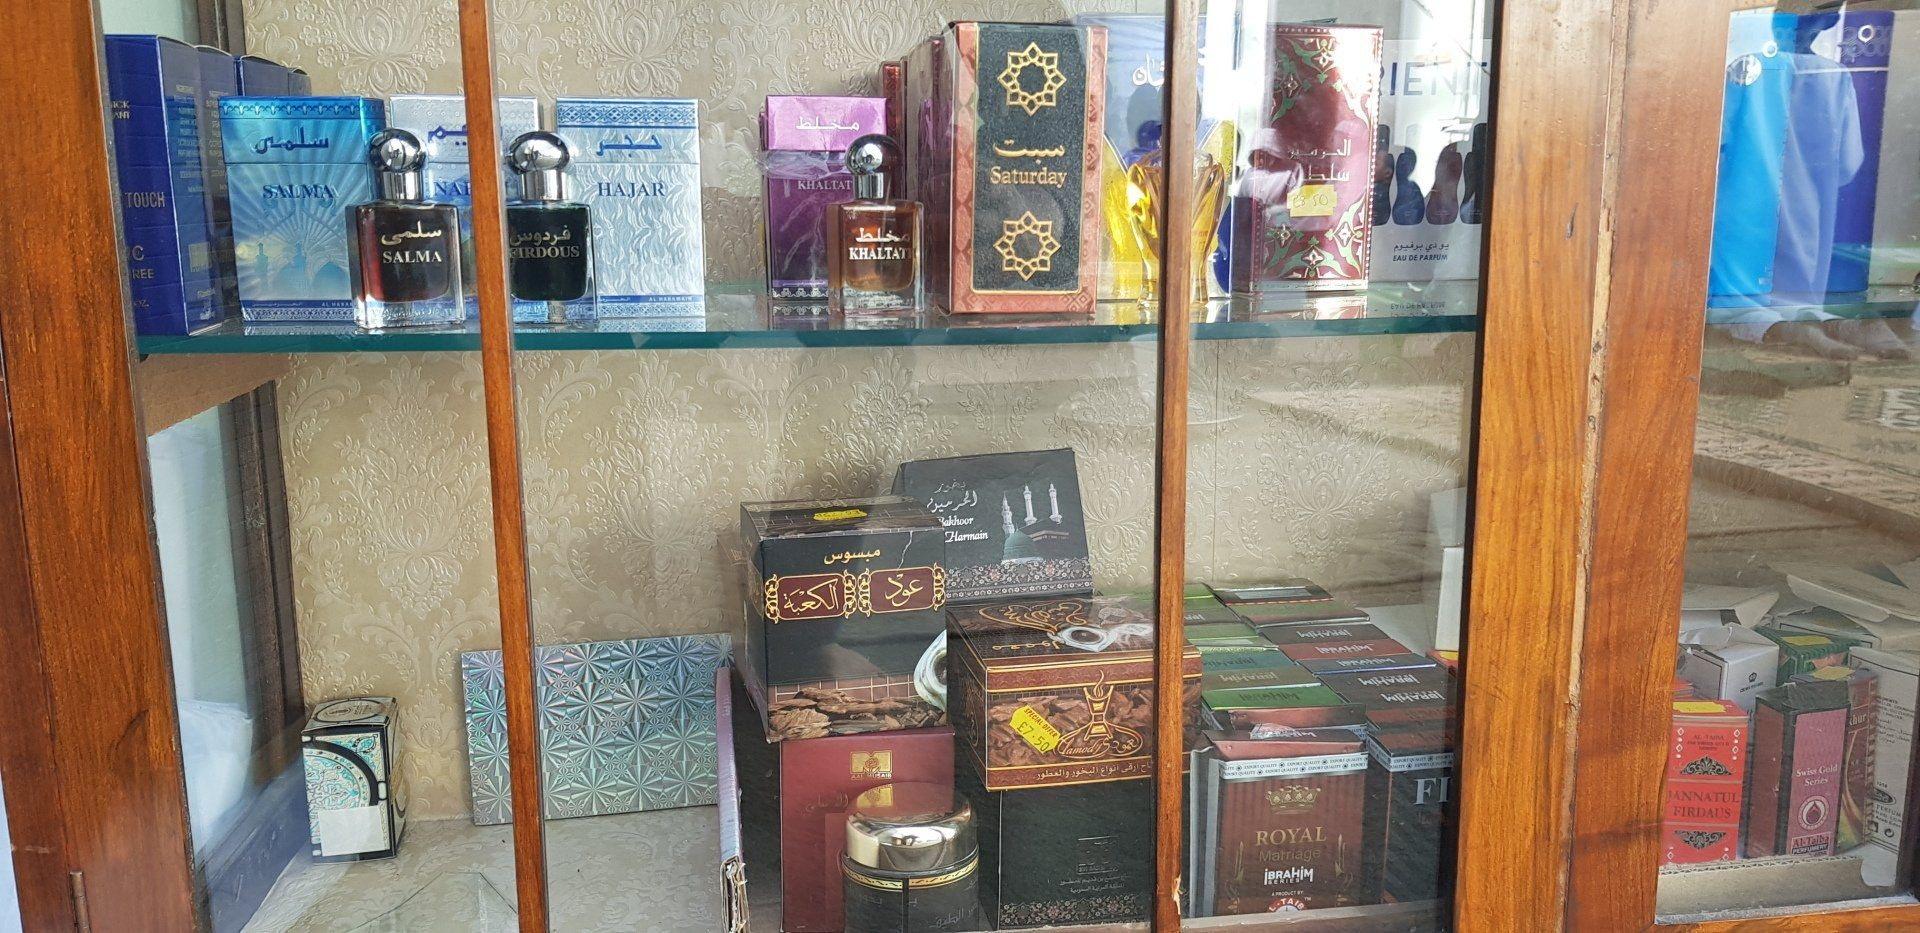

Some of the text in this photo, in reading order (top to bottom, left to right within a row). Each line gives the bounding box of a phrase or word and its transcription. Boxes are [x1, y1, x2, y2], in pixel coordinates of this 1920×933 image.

[990, 166, 1067, 189] Saturday
[263, 184, 334, 199] SALMA
[597, 182, 667, 197] HAJAR
[125, 192, 165, 208] TOUCH
[383, 251, 442, 263] SALMA
[132, 269, 155, 279] REE
[944, 529, 989, 543] Harmain
[1023, 708, 1043, 726] SPECIAL
[1016, 721, 1050, 752] £7.50
[1796, 764, 1838, 777] Swiss Gold
[1804, 778, 1828, 787] Series
[1673, 806, 1731, 819] FIRDAUS
[1255, 826, 1327, 846] ROYAL
[1260, 849, 1321, 863] Marriage
